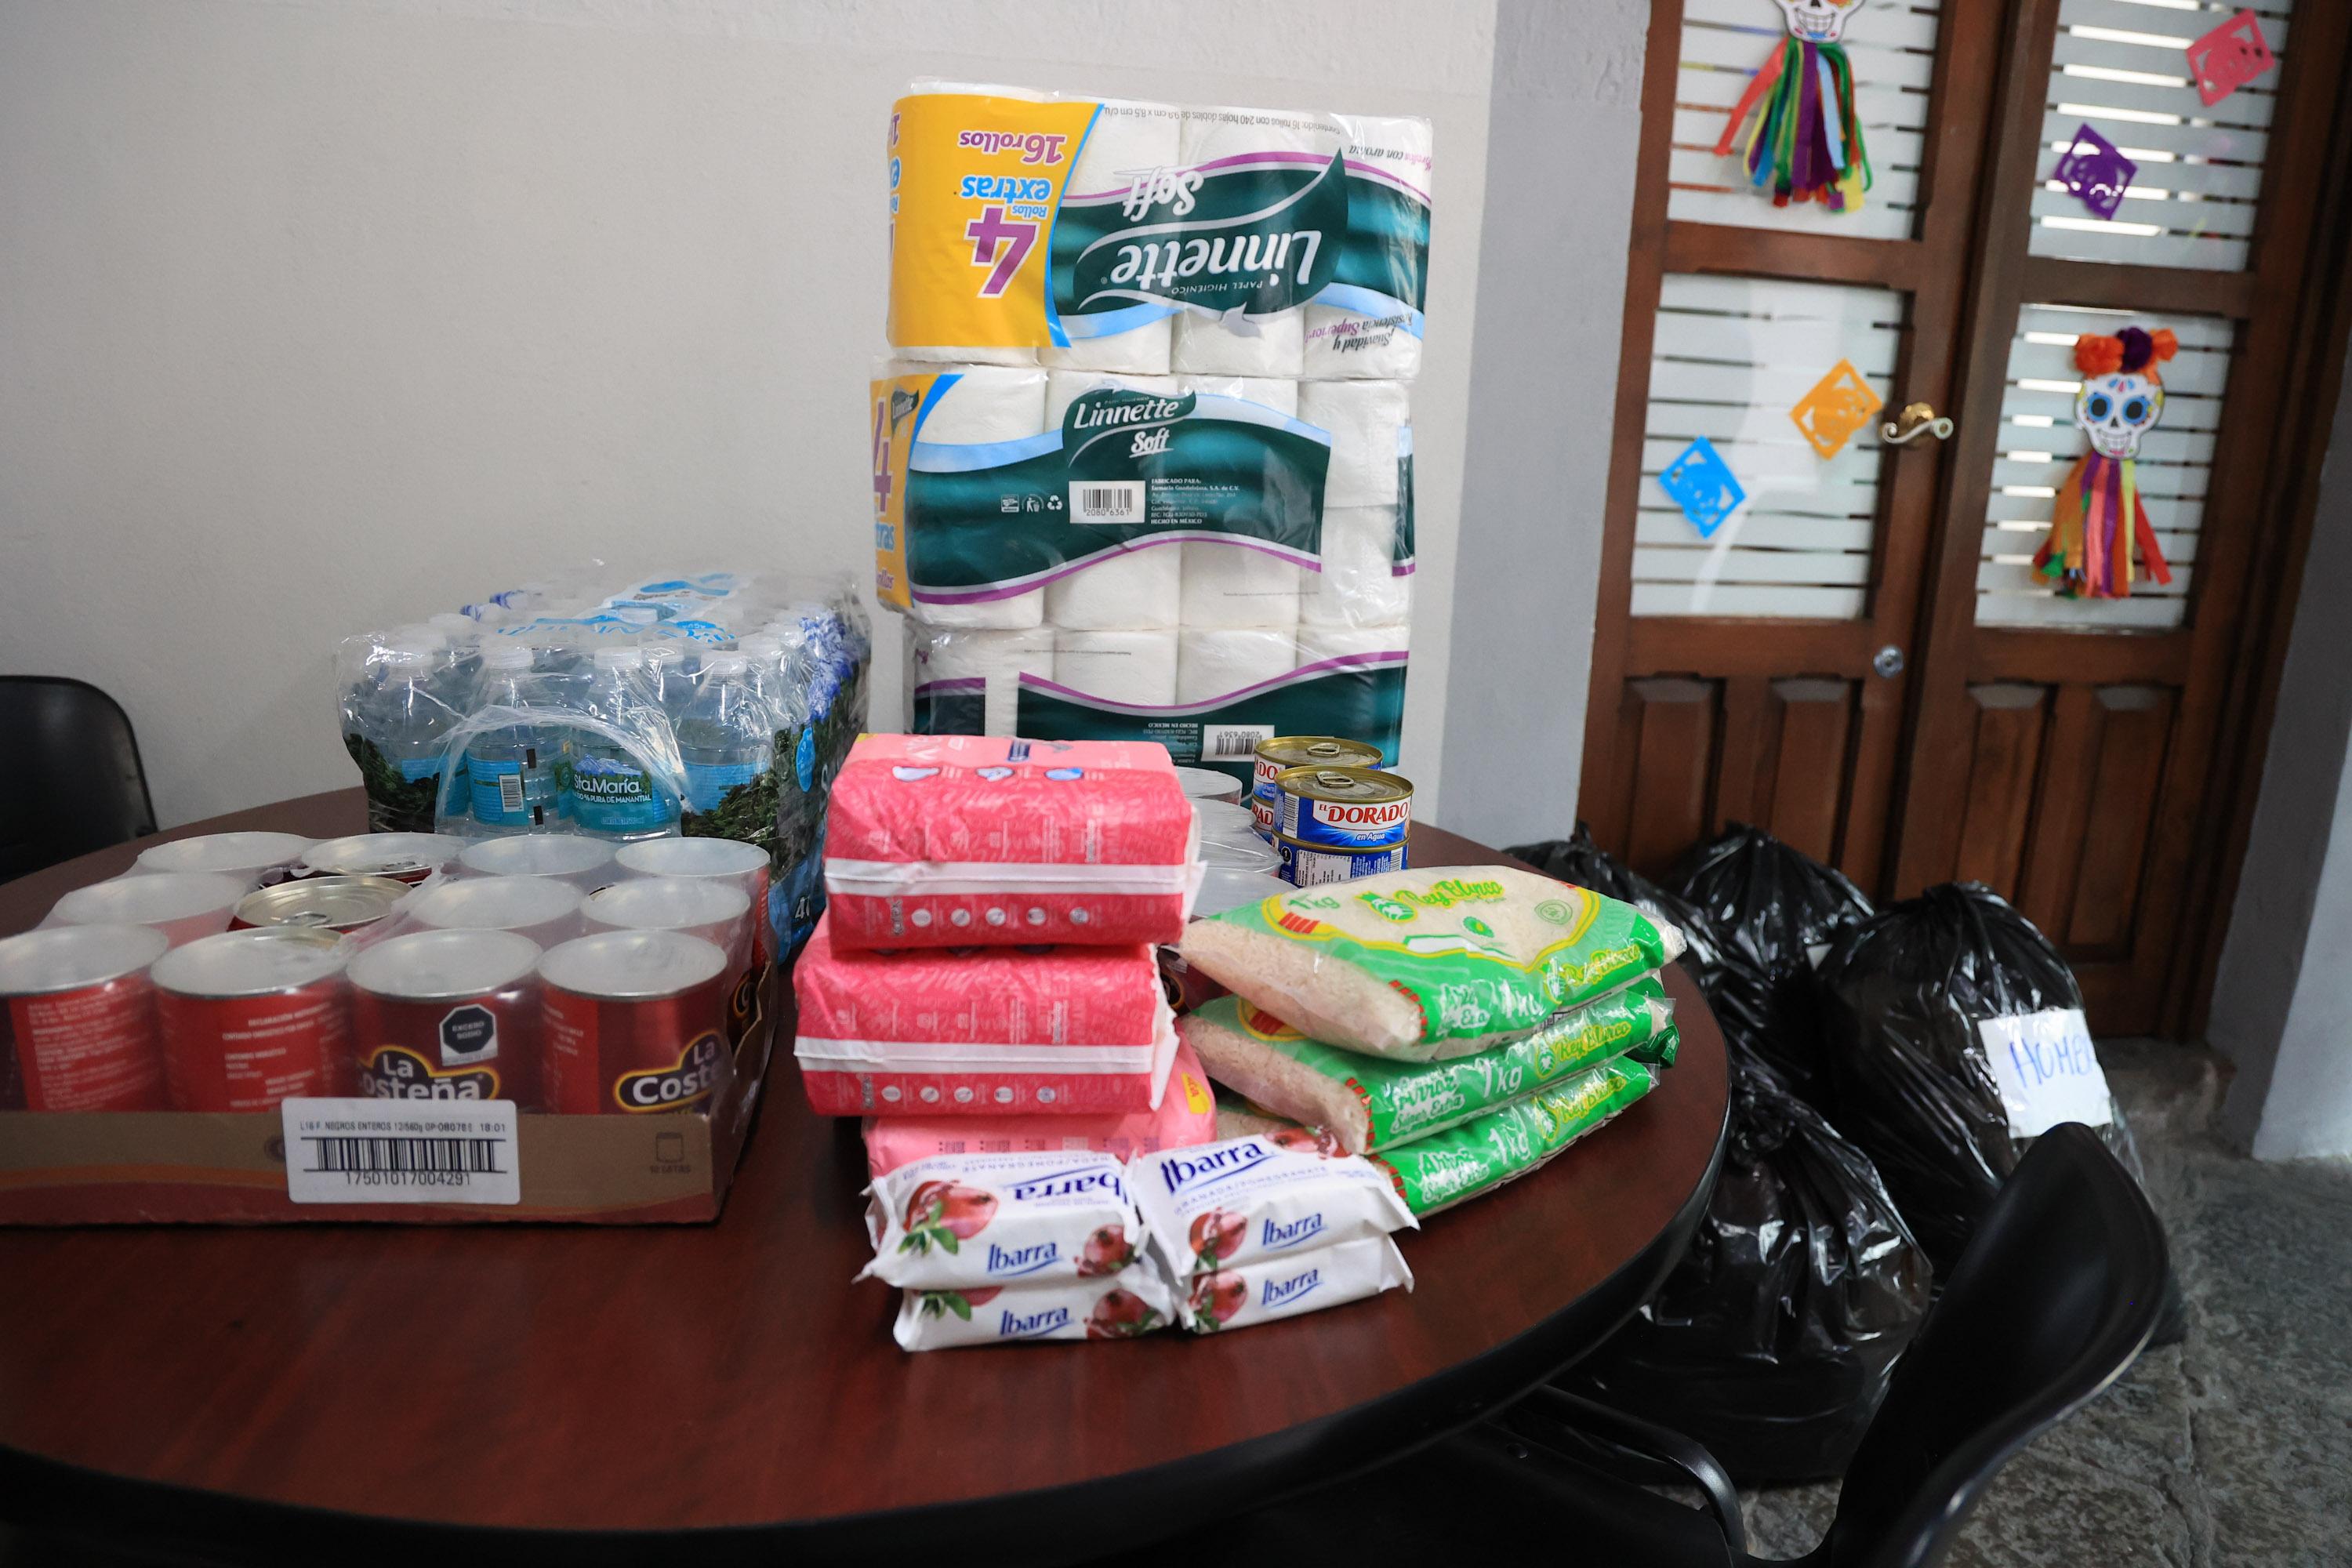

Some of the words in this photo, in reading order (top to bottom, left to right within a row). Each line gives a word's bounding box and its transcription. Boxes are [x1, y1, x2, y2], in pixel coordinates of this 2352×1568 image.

[1181, 111, 1191, 119] de
[1192, 111, 1218, 123] dobles
[1218, 114, 1239, 125] hojas
[1240, 116, 1254, 125] 240
[1256, 117, 1270, 125] con
[959, 132, 1022, 154] rollos
[1022, 134, 1065, 164] 16
[1386, 148, 1403, 159] con
[960, 175, 1052, 205] extras
[1123, 166, 1204, 222] Soft
[1011, 205, 1048, 218] Rollos
[966, 205, 1040, 296] 4
[1110, 230, 1322, 290] Linnette
[1232, 281, 1263, 289] PAPEL
[1333, 335, 1341, 351] y
[1073, 397, 1179, 430] Linnette
[1131, 427, 1171, 453] Soft
[615, 794, 652, 803] MANANTIAL
[1328, 802, 1408, 825] DORADO
[1367, 833, 1385, 842] Agua
[1396, 889, 1454, 906] Rey
[1584, 1022, 1630, 1049] Blanco
[693, 1040, 716, 1065] La
[383, 1053, 413, 1078] La
[362, 1077, 481, 1099] osteña
[325, 1122, 355, 1131] NEGROS
[358, 1122, 391, 1131] ENTEROS
[347, 1172, 470, 1185] 17501017004291
[1160, 1142, 1265, 1195] Ibarra
[1262, 1212, 1323, 1247] Ibarra
[986, 1241, 1058, 1273] Ibarra
[1261, 1268, 1319, 1306] Ibarra
[999, 1307, 1069, 1336] Ibarra
